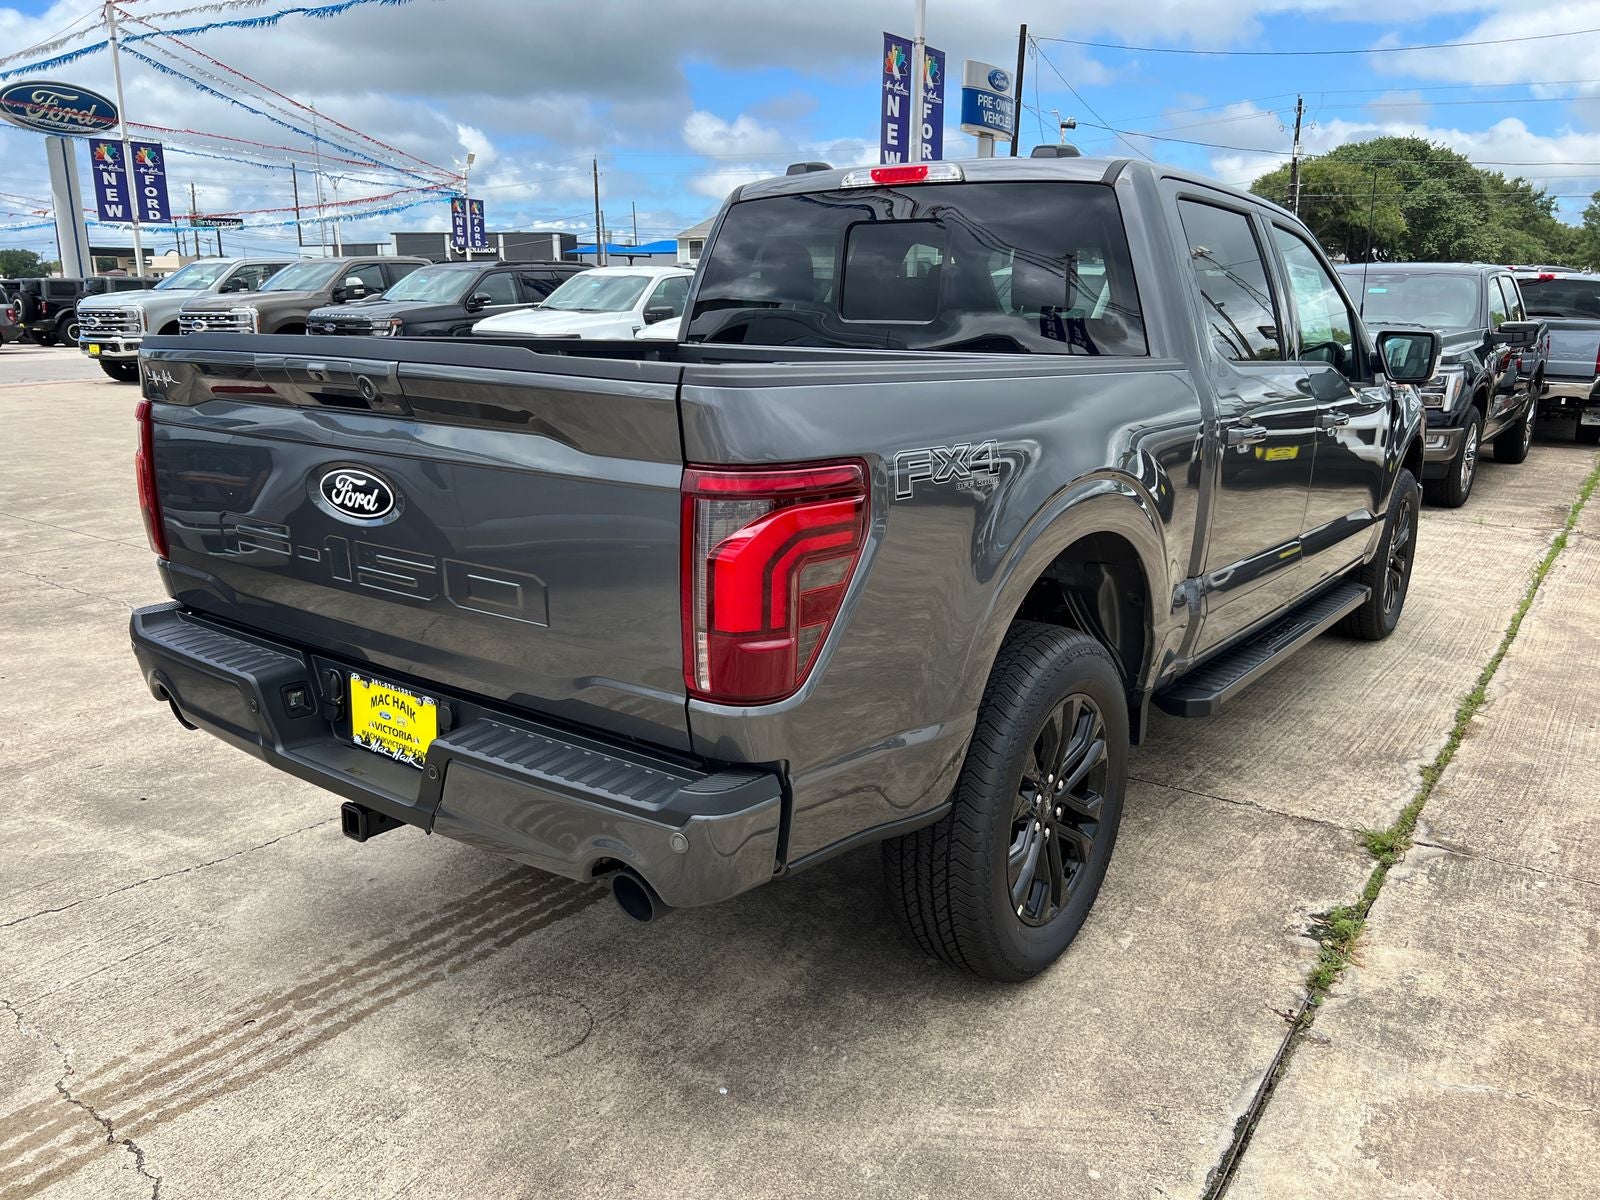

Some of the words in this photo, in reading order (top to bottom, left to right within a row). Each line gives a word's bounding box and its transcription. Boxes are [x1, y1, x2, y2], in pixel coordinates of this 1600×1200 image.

[25, 90, 98, 125] Ford
[977, 94, 1014, 114] PRE-OWNE
[983, 110, 1012, 129] VEHICLES
[884, 95, 901, 164] NEW
[922, 103, 933, 160] FOR
[102, 171, 123, 218] NEW
[144, 175, 161, 220] FORD
[196, 219, 243, 228] enterprise
[455, 217, 465, 245] NEW
[473, 219, 482, 247] FORD
[894, 439, 1000, 500] FX4
[332, 474, 379, 512] Ford
[221, 511, 549, 628] F-150
[371, 694, 390, 708] MAC
[392, 696, 416, 723] HAIK
[375, 721, 413, 743] VICTORIA
[368, 739, 392, 756] Mac
[392, 749, 420, 766] Haik
